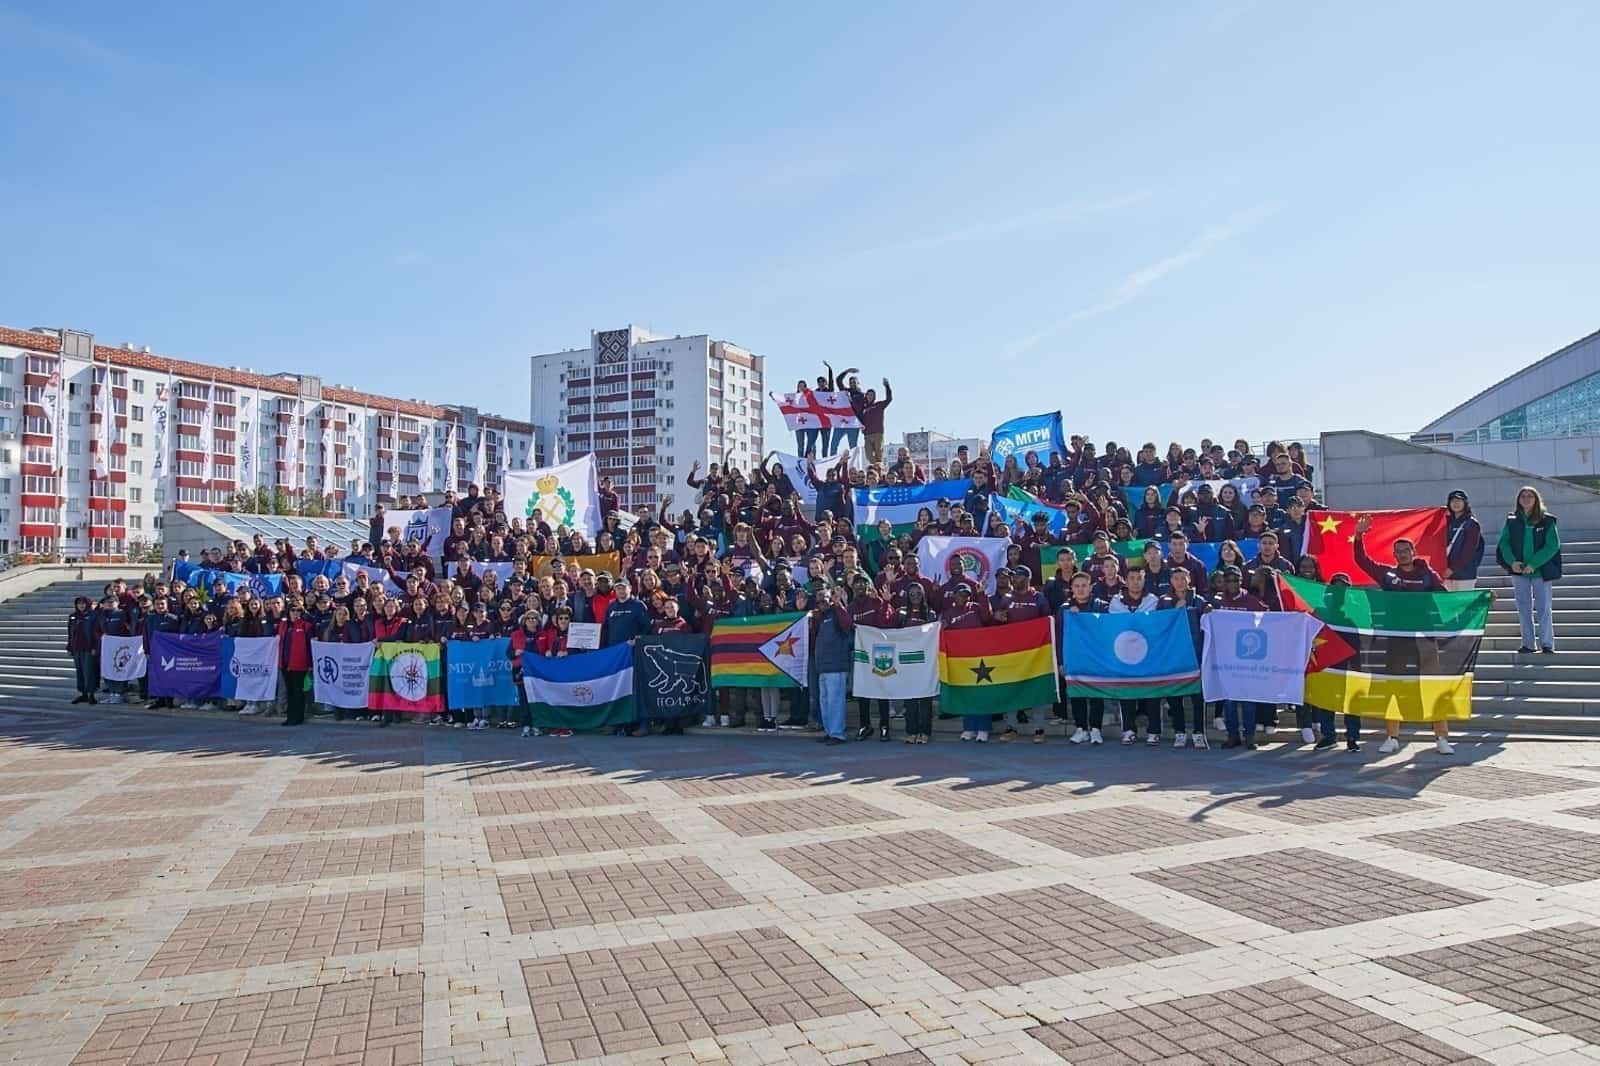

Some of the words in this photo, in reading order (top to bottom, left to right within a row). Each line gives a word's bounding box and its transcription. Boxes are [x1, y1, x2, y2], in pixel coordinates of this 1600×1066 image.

[1015, 427, 1050, 446] МГРИ
[448, 663, 474, 673] МГУ
[487, 659, 513, 672] 270
